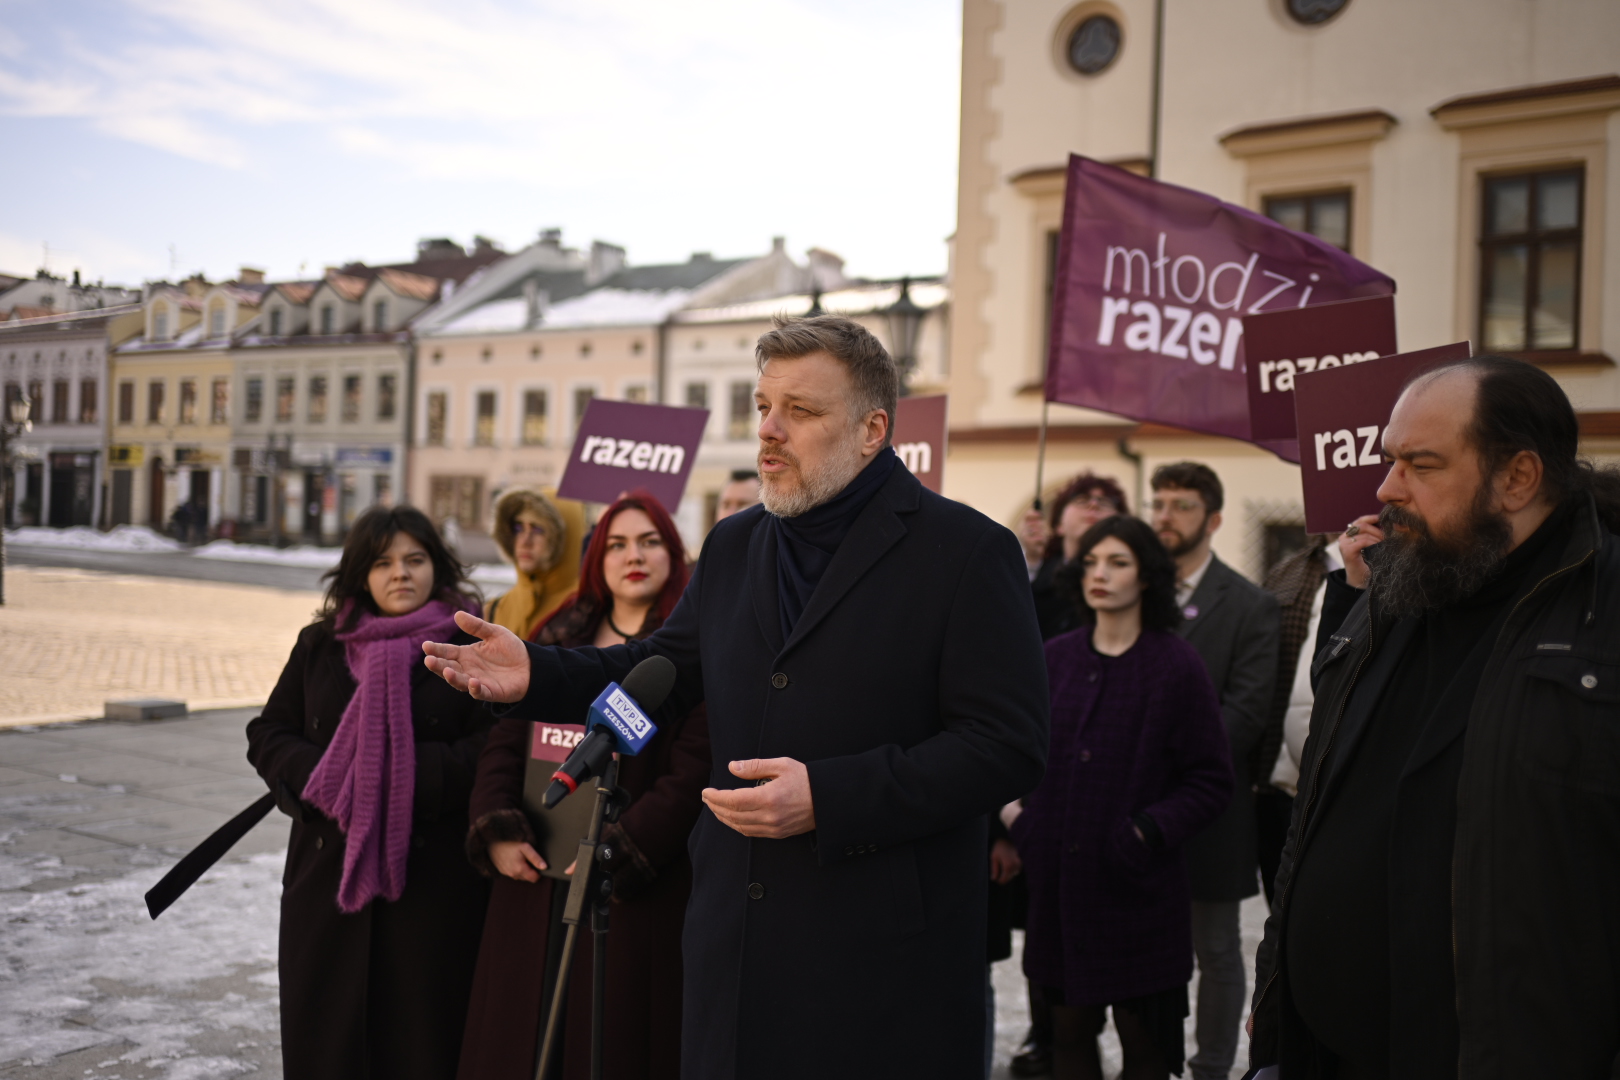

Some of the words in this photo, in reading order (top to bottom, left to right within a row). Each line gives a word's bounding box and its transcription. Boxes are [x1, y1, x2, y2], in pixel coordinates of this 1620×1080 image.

[1103, 232, 1321, 316] młodzi
[580, 435, 685, 475] razem
[1314, 425, 1382, 471] raz
[541, 726, 586, 748] raze
[603, 707, 635, 741] RZESZÓW
